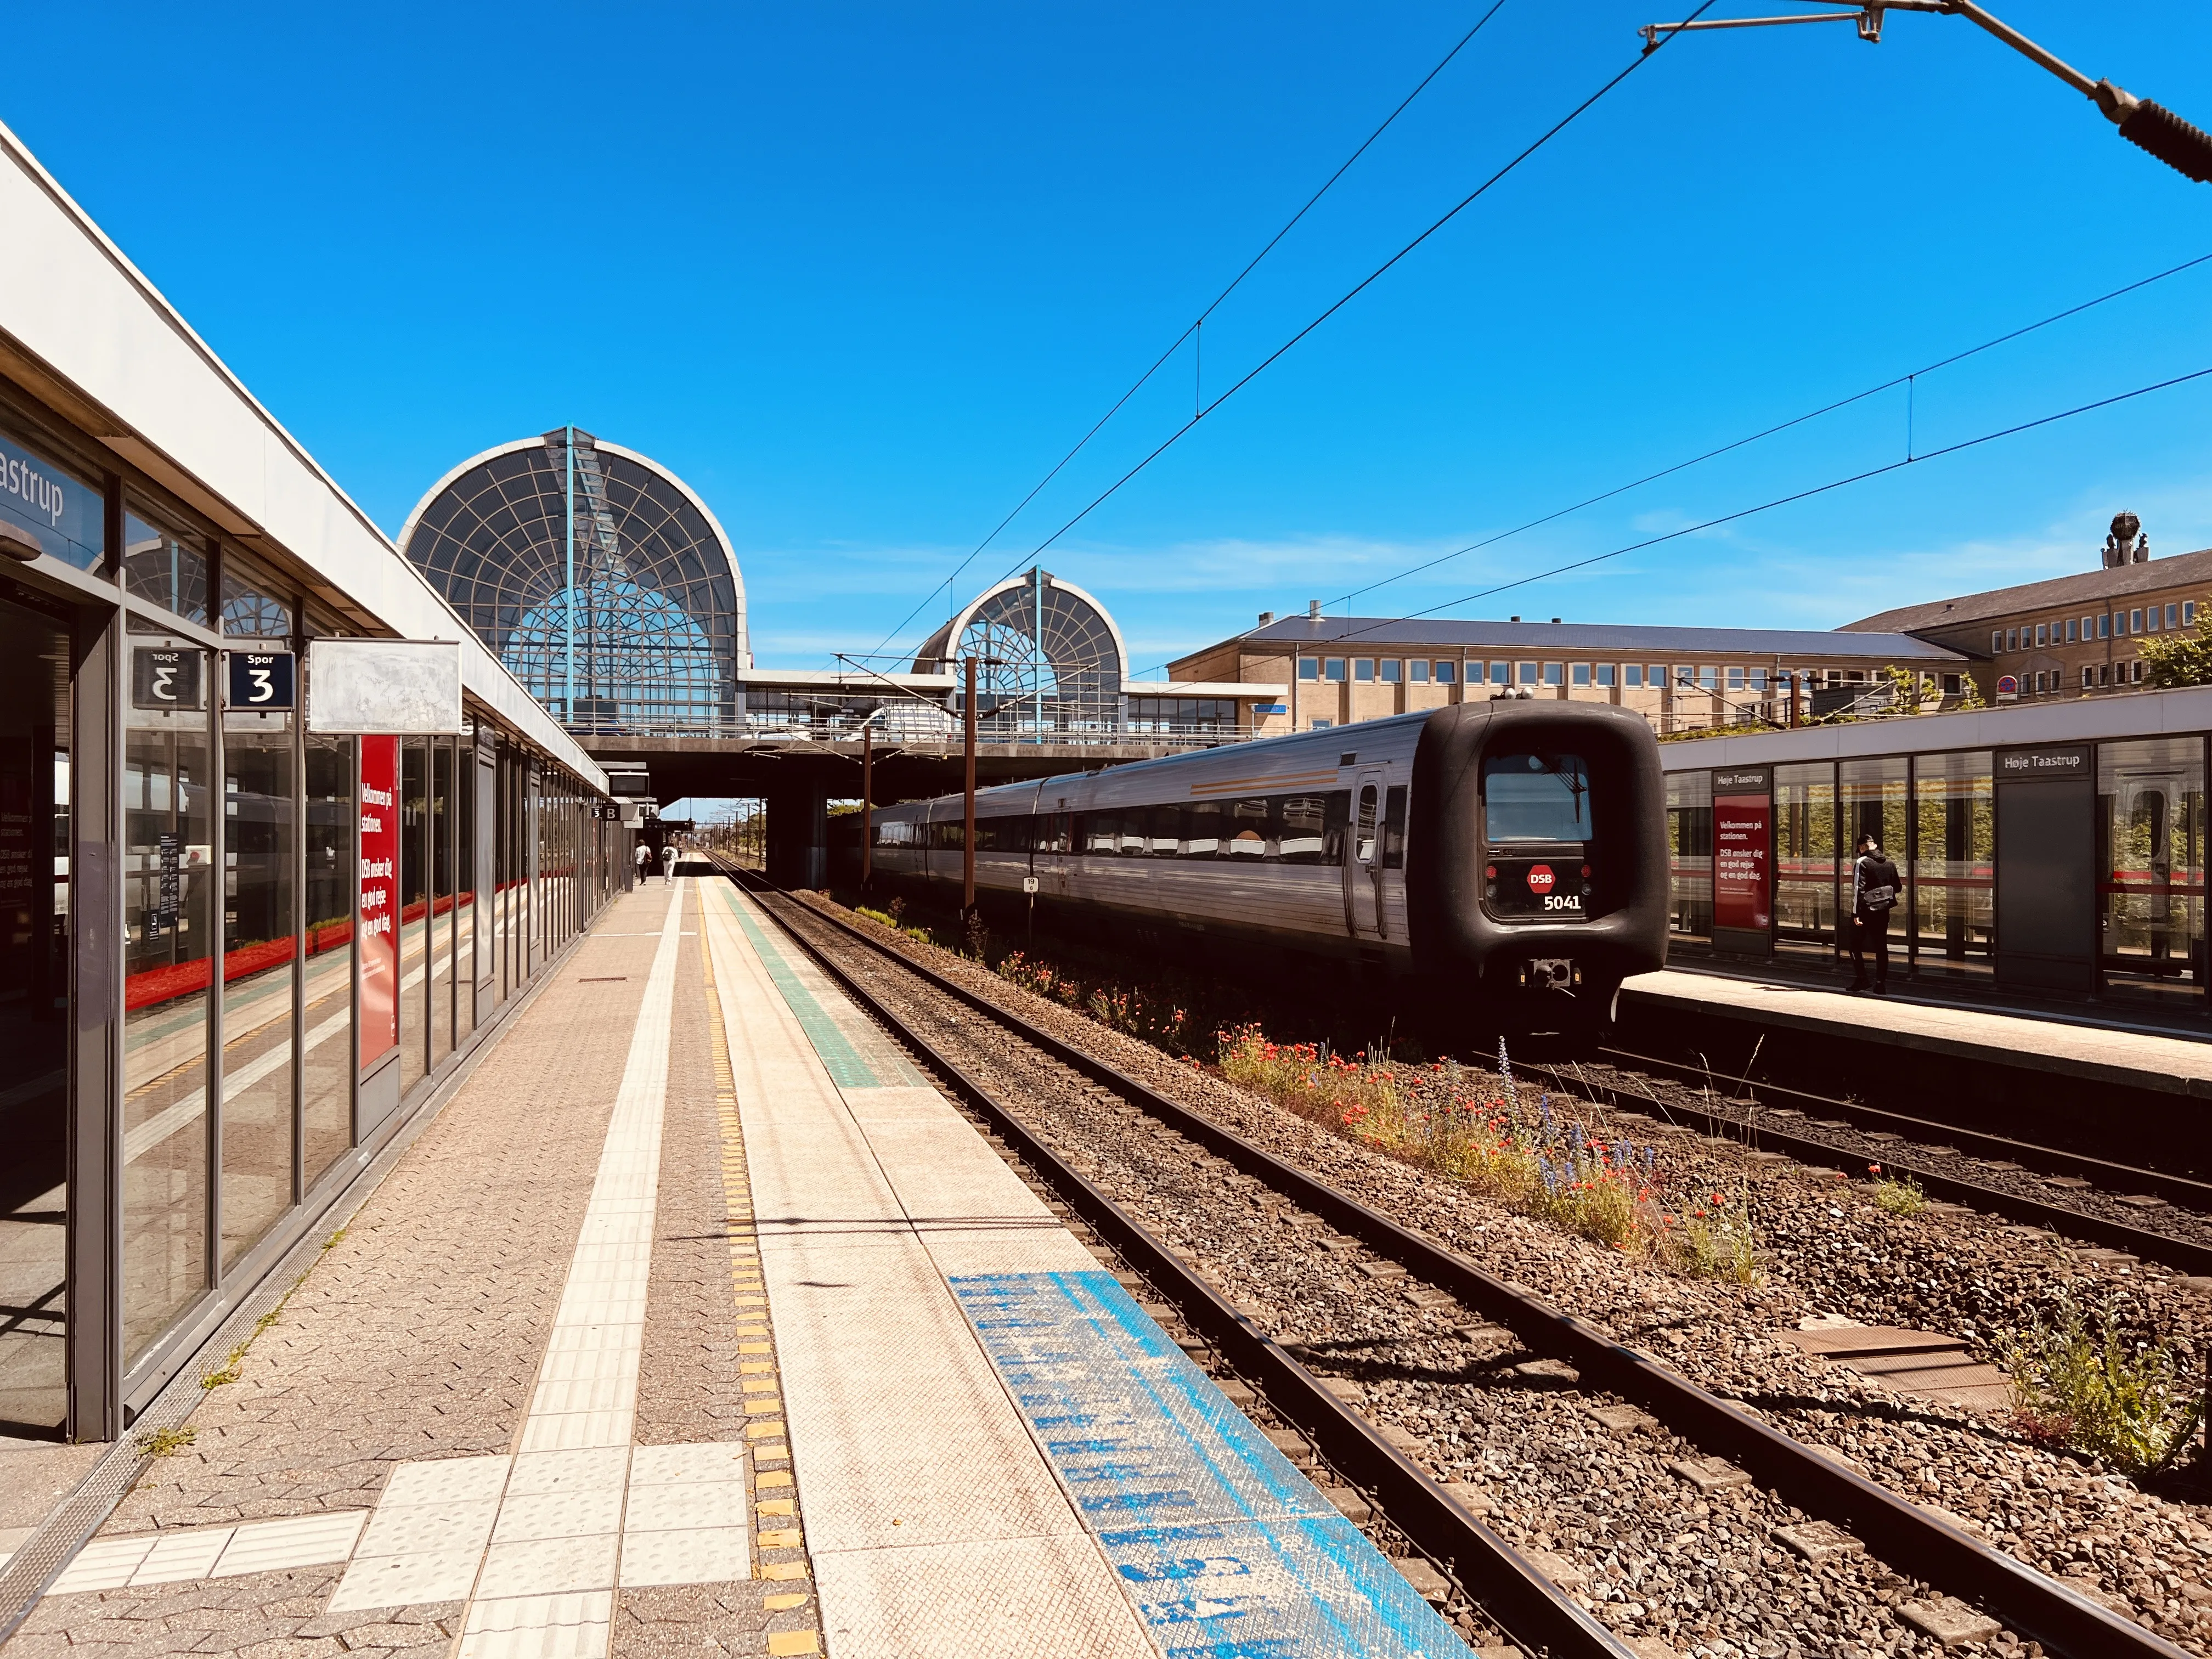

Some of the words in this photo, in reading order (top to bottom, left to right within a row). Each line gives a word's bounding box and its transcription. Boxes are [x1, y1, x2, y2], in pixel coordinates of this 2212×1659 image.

[247, 654, 274, 664] Spor
[249, 669, 273, 702] 3
[2005, 757, 2029, 770] Høje
[2032, 755, 2080, 768] Taastrup
[1718, 775, 1733, 786] Høje
[1734, 775, 1763, 785] Taastrup
[362, 782, 386, 805] Velkommen
[386, 787, 392, 811] på
[607, 808, 616, 819] B
[362, 812, 382, 833] stationen.
[1720, 821, 1753, 829] Velkommen
[1754, 820, 1762, 831] på
[1720, 849, 1731, 857] DSB
[1733, 849, 1753, 857] ønsker
[1753, 849, 1763, 859] dig
[362, 858, 370, 879] DSB
[370, 857, 385, 878] ønsker
[1728, 860, 1740, 869] god
[1740, 860, 1754, 870] rejse
[1530, 874, 1553, 884] DSB
[1737, 871, 1748, 880] god
[362, 893, 367, 909] en
[375, 885, 386, 909] rejse
[1544, 895, 1581, 911] 5041
[362, 920, 368, 940] og
[368, 920, 373, 936] en
[373, 912, 381, 938] god
